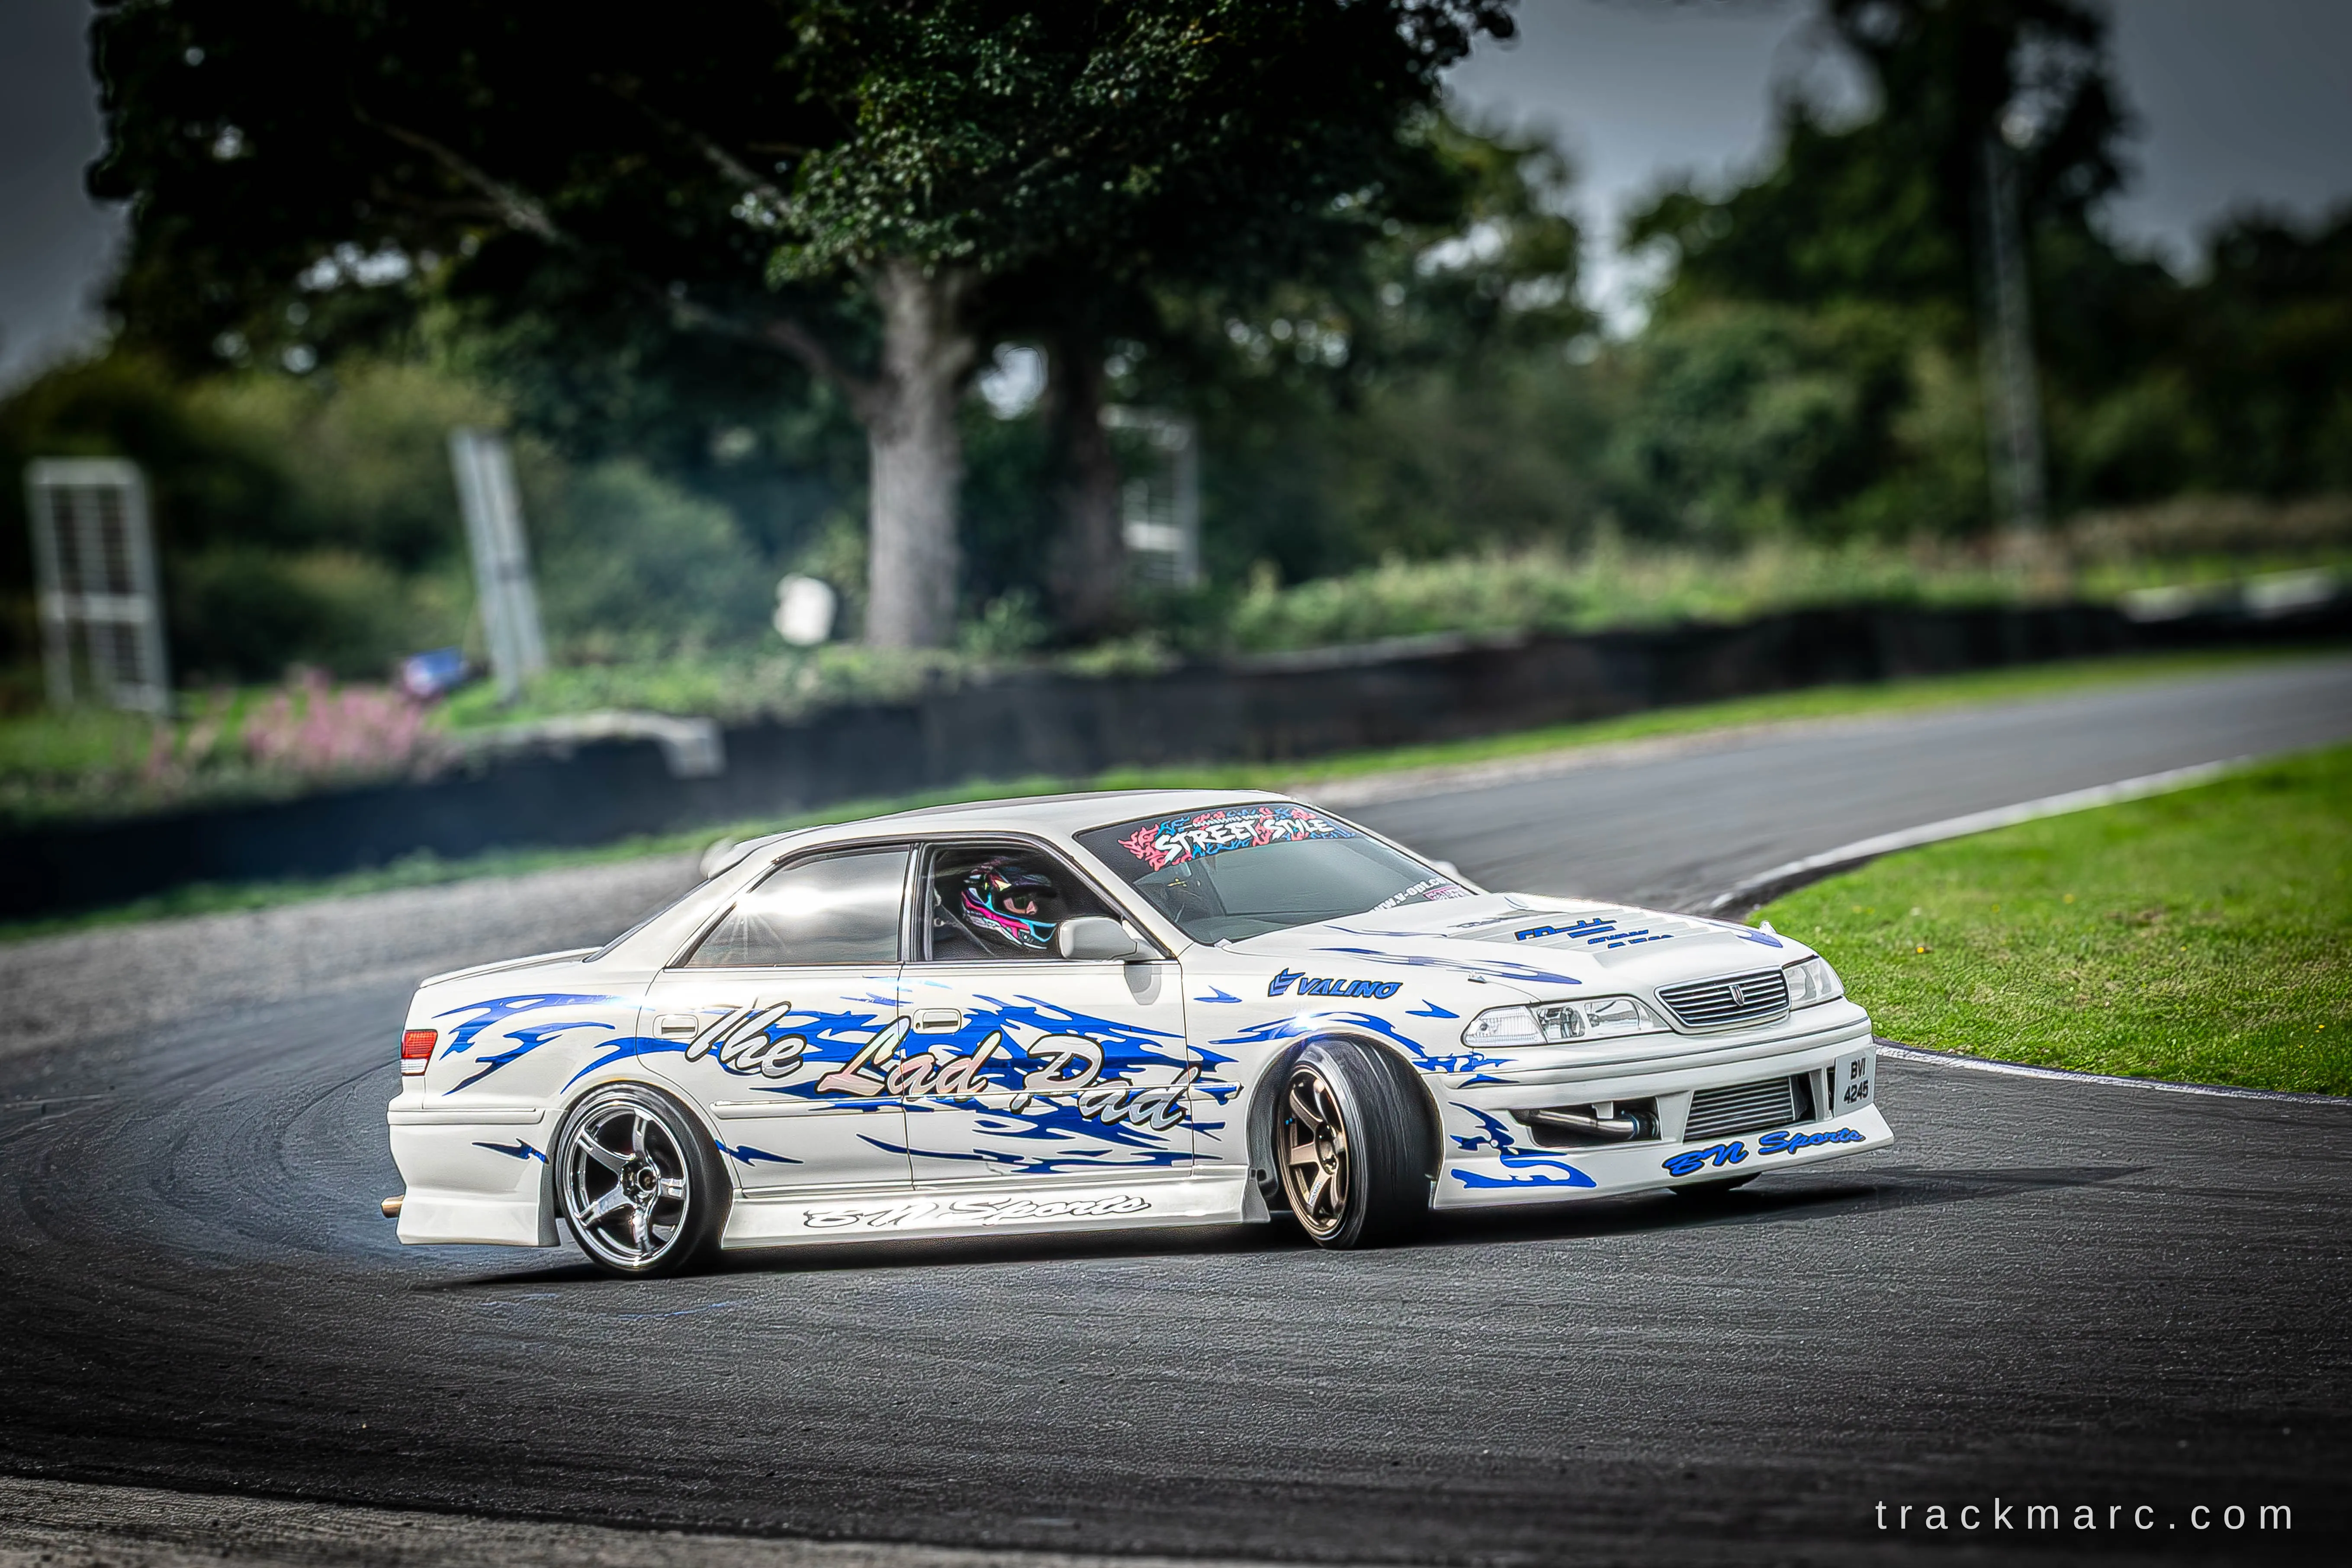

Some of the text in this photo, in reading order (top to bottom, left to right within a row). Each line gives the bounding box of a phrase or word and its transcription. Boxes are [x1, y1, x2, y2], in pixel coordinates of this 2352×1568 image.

[1155, 820, 1259, 864] STREET
[1263, 819, 1335, 841] STYLE
[1297, 977, 1403, 999] VALINO
[685, 997, 1202, 1131] The Lad Pad
[1843, 1079, 1869, 1104] 4245
[1663, 1128, 1866, 1176] BN Sports
[940, 1195, 1151, 1226] Sports
